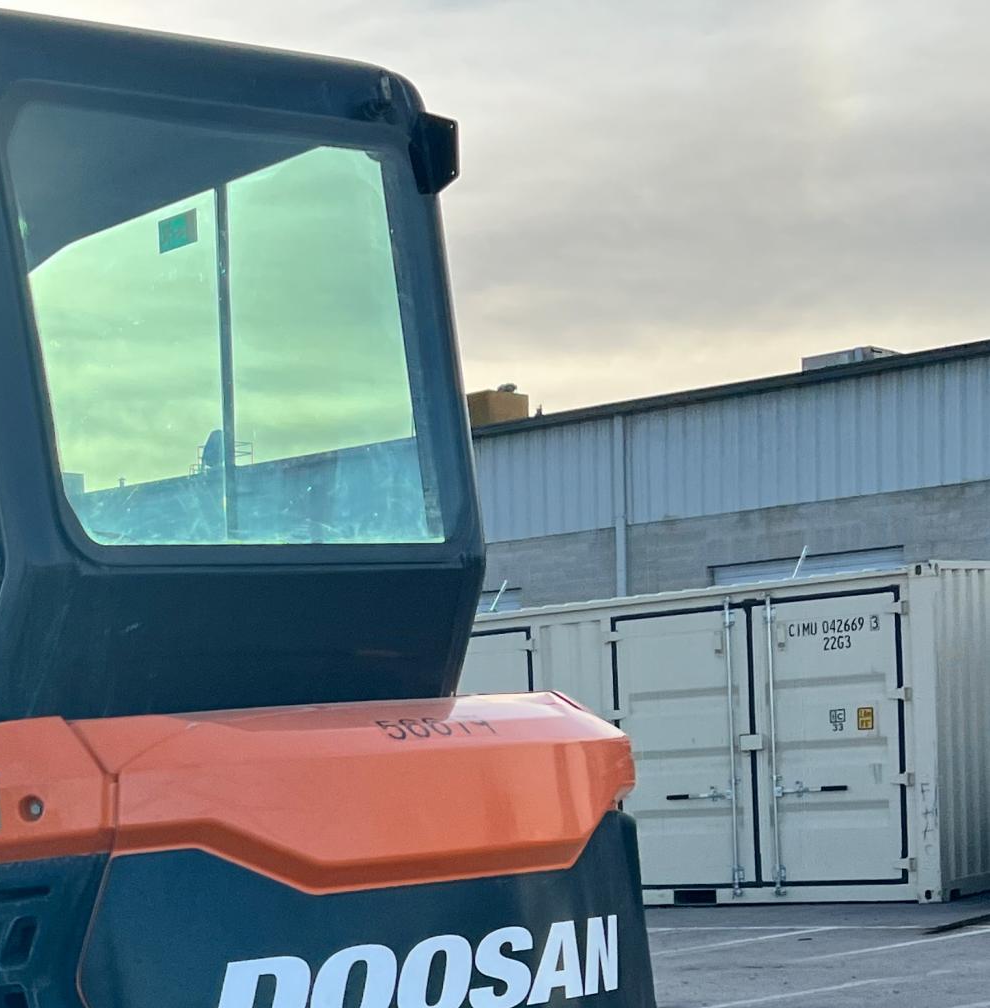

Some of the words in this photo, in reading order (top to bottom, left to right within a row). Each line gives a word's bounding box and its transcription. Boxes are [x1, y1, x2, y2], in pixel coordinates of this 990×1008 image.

[788, 621, 818, 638] CIMU
[821, 616, 865, 634] 042669
[869, 614, 880, 631] 3
[823, 634, 852, 651] 22G3
